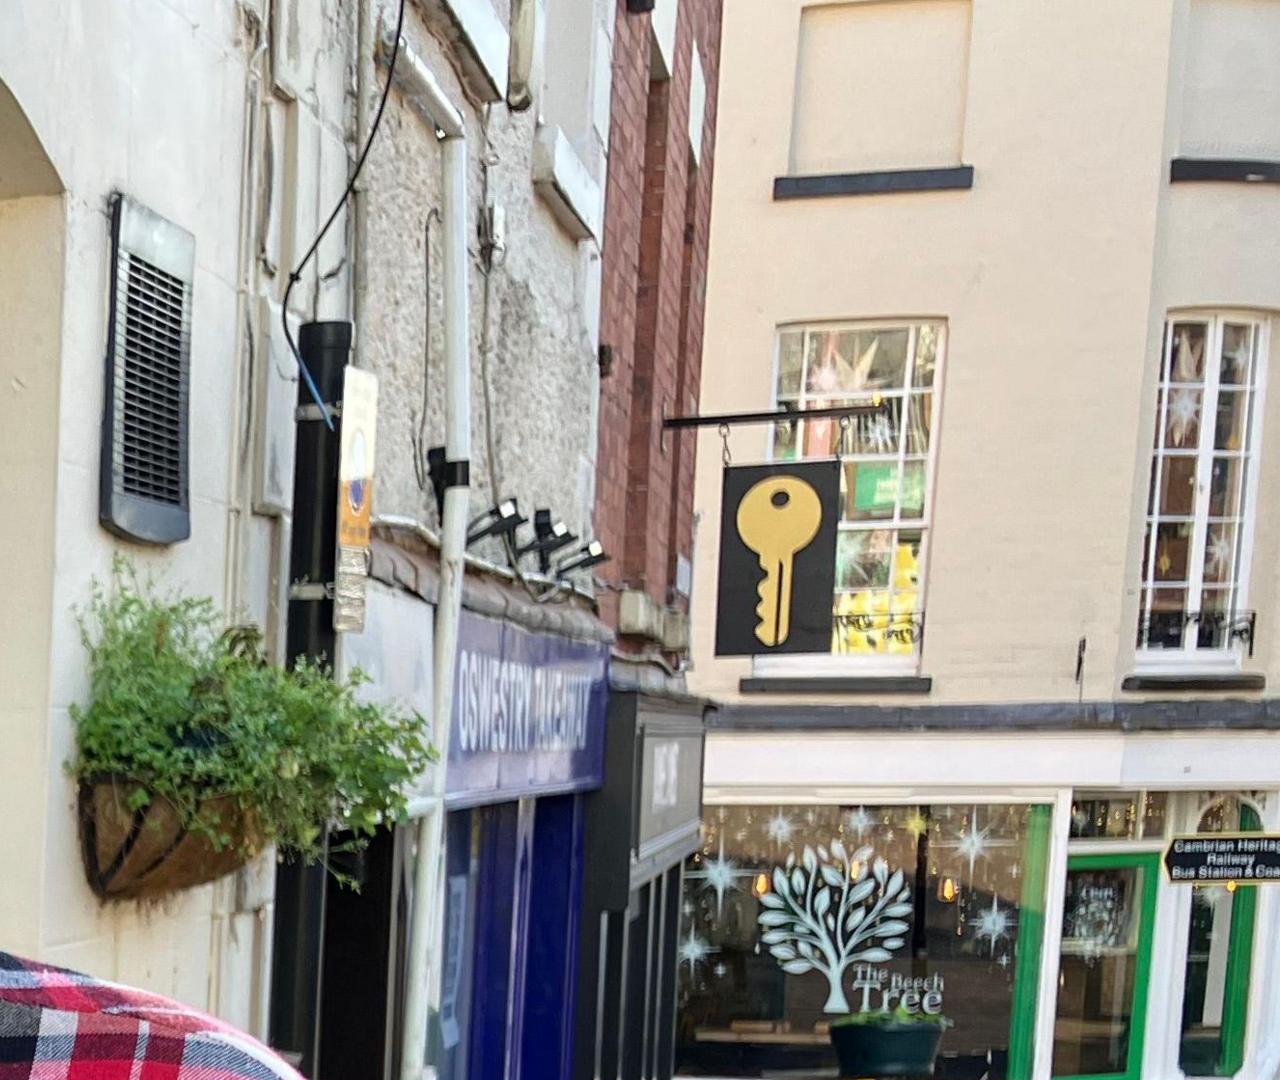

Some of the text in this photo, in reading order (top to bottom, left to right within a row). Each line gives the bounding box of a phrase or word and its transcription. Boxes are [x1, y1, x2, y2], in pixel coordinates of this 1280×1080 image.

[458, 648, 532, 752] OSWESTRY
[1174, 839, 1235, 853] Cambrian
[1207, 853, 1255, 867] Railway
[1172, 866, 1196, 879] Bus
[1199, 865, 1242, 878] Station
[853, 963, 888, 982] The
[852, 980, 943, 1015] Tree
